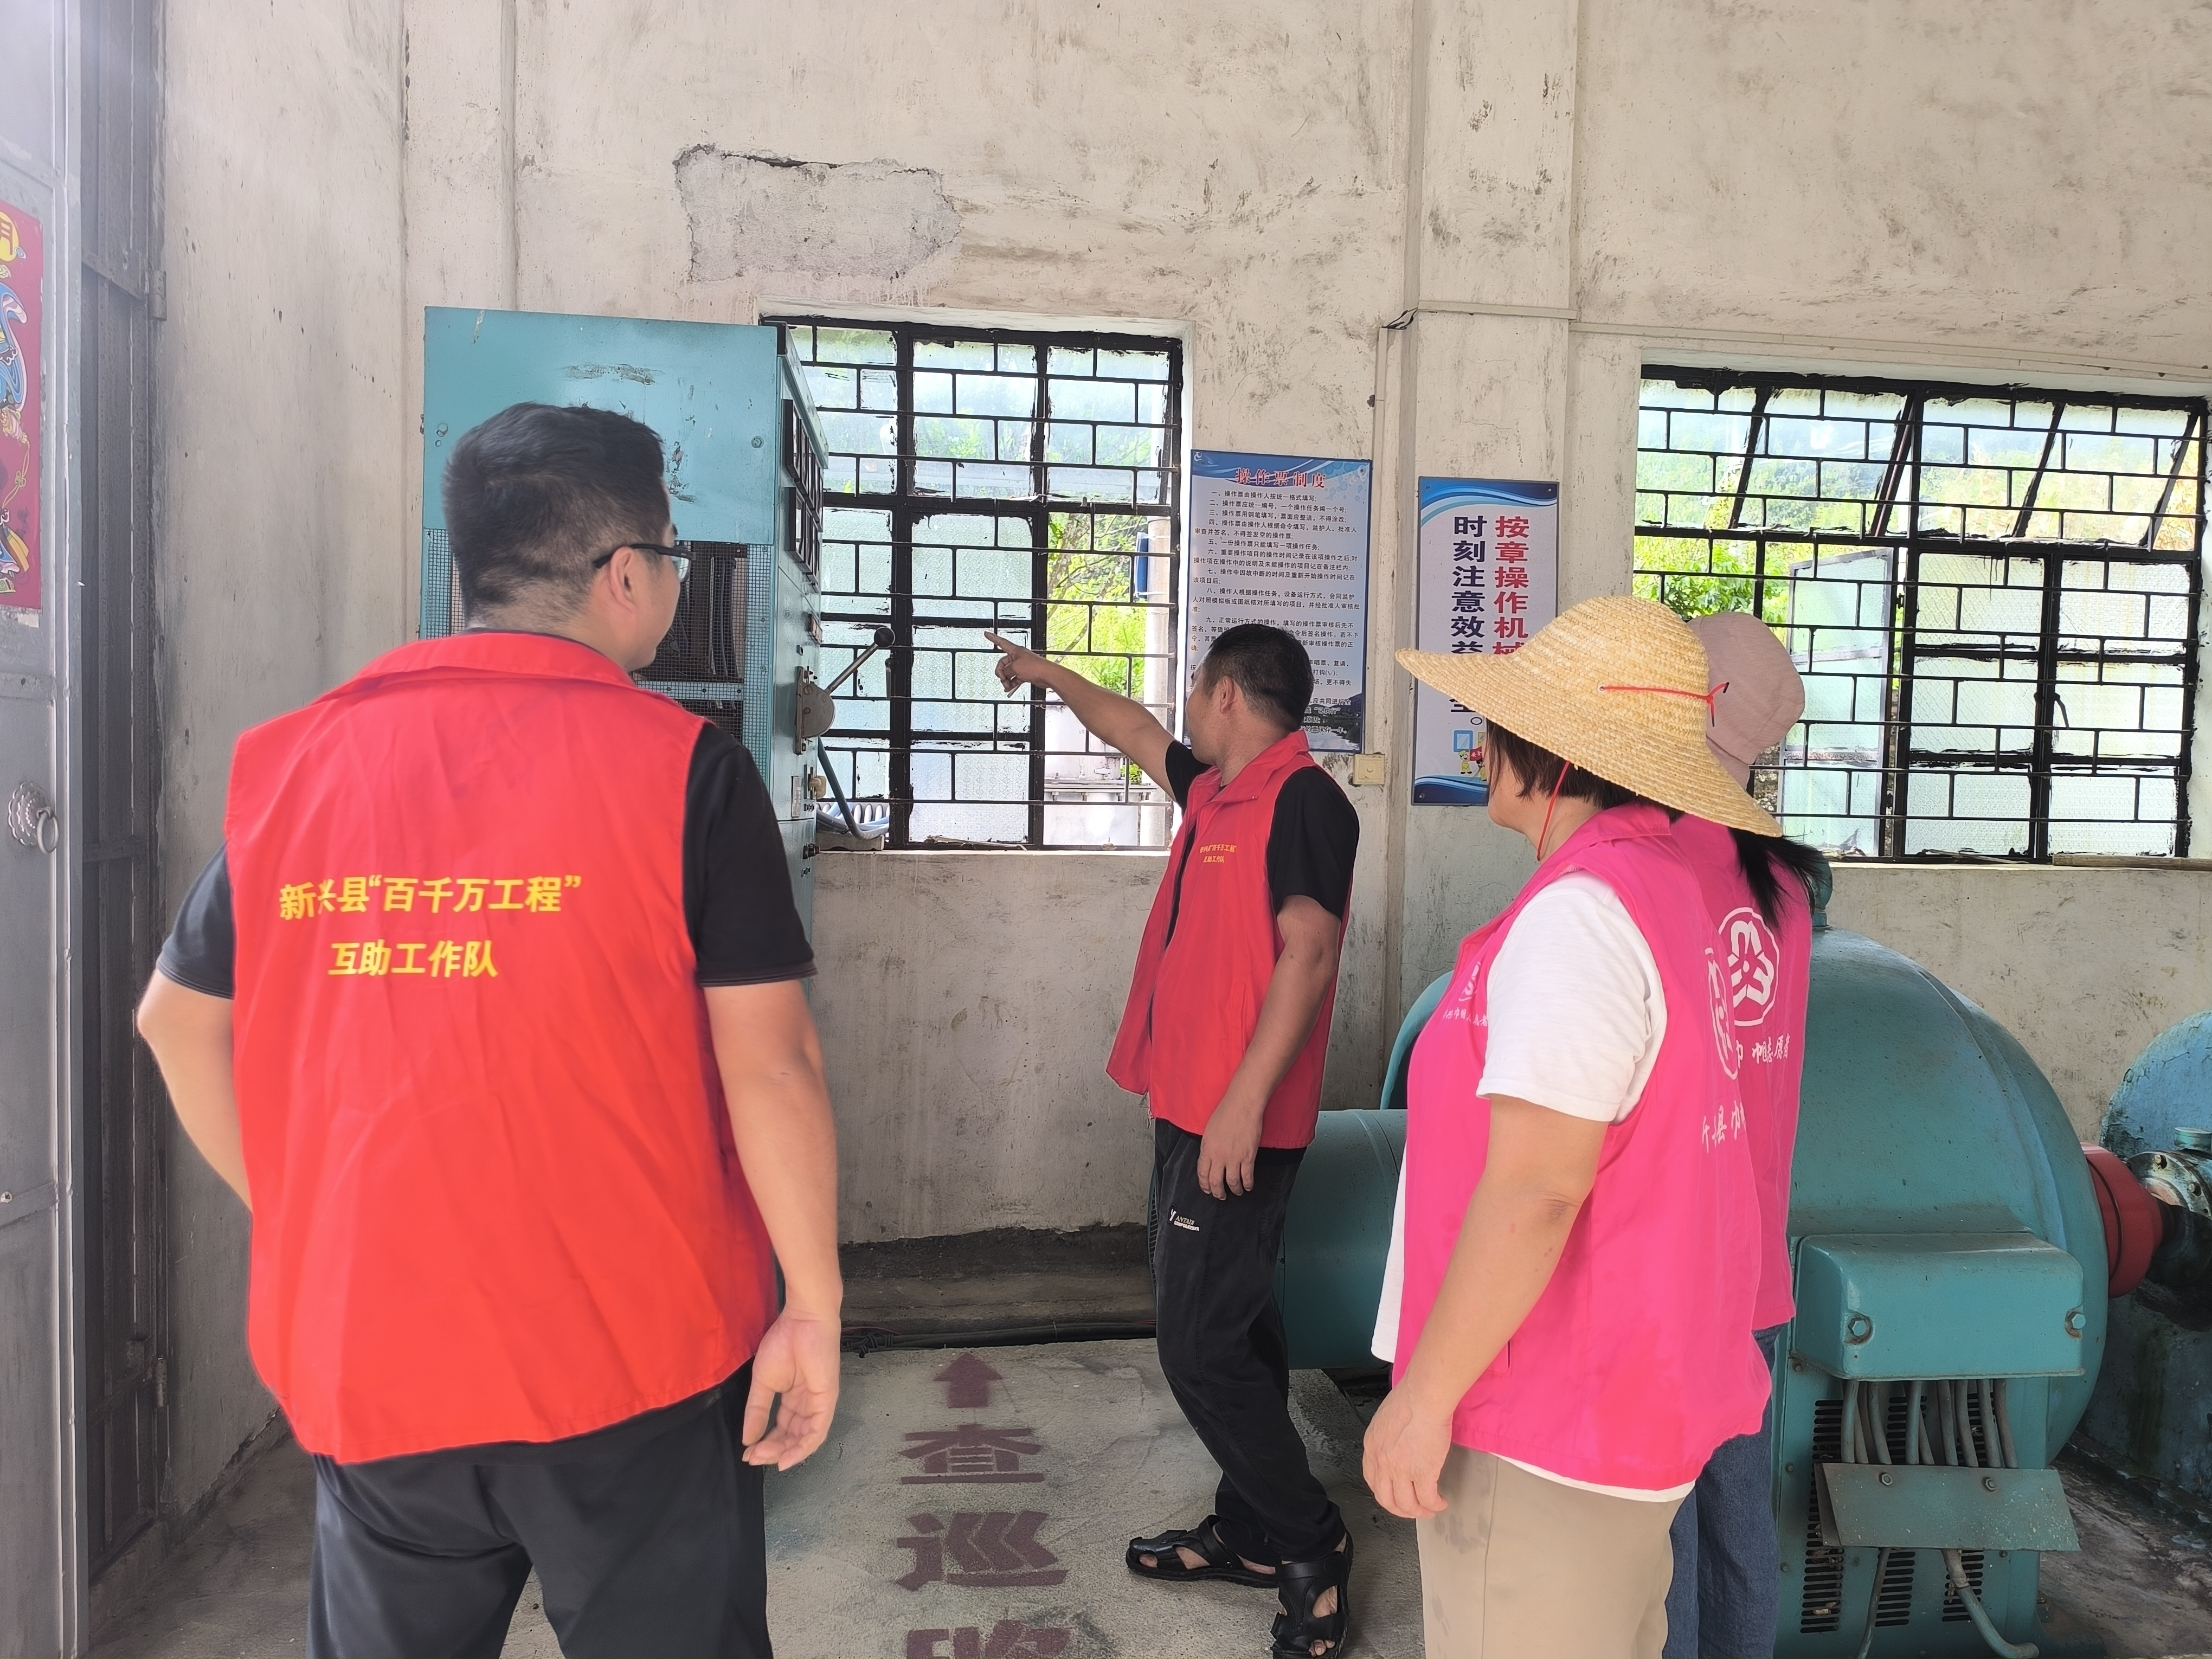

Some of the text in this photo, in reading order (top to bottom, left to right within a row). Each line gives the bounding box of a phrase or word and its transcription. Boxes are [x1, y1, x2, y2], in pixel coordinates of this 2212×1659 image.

[1235, 468, 1326, 489] 操作票制度
[1211, 491, 1316, 501] 一、操作票由操作人按统一格式填写;
[1207, 568, 1355, 581] 七、操作中因故中断的时间及重新开始操作时间记在
[327, 939, 499, 978] 互助工作队
